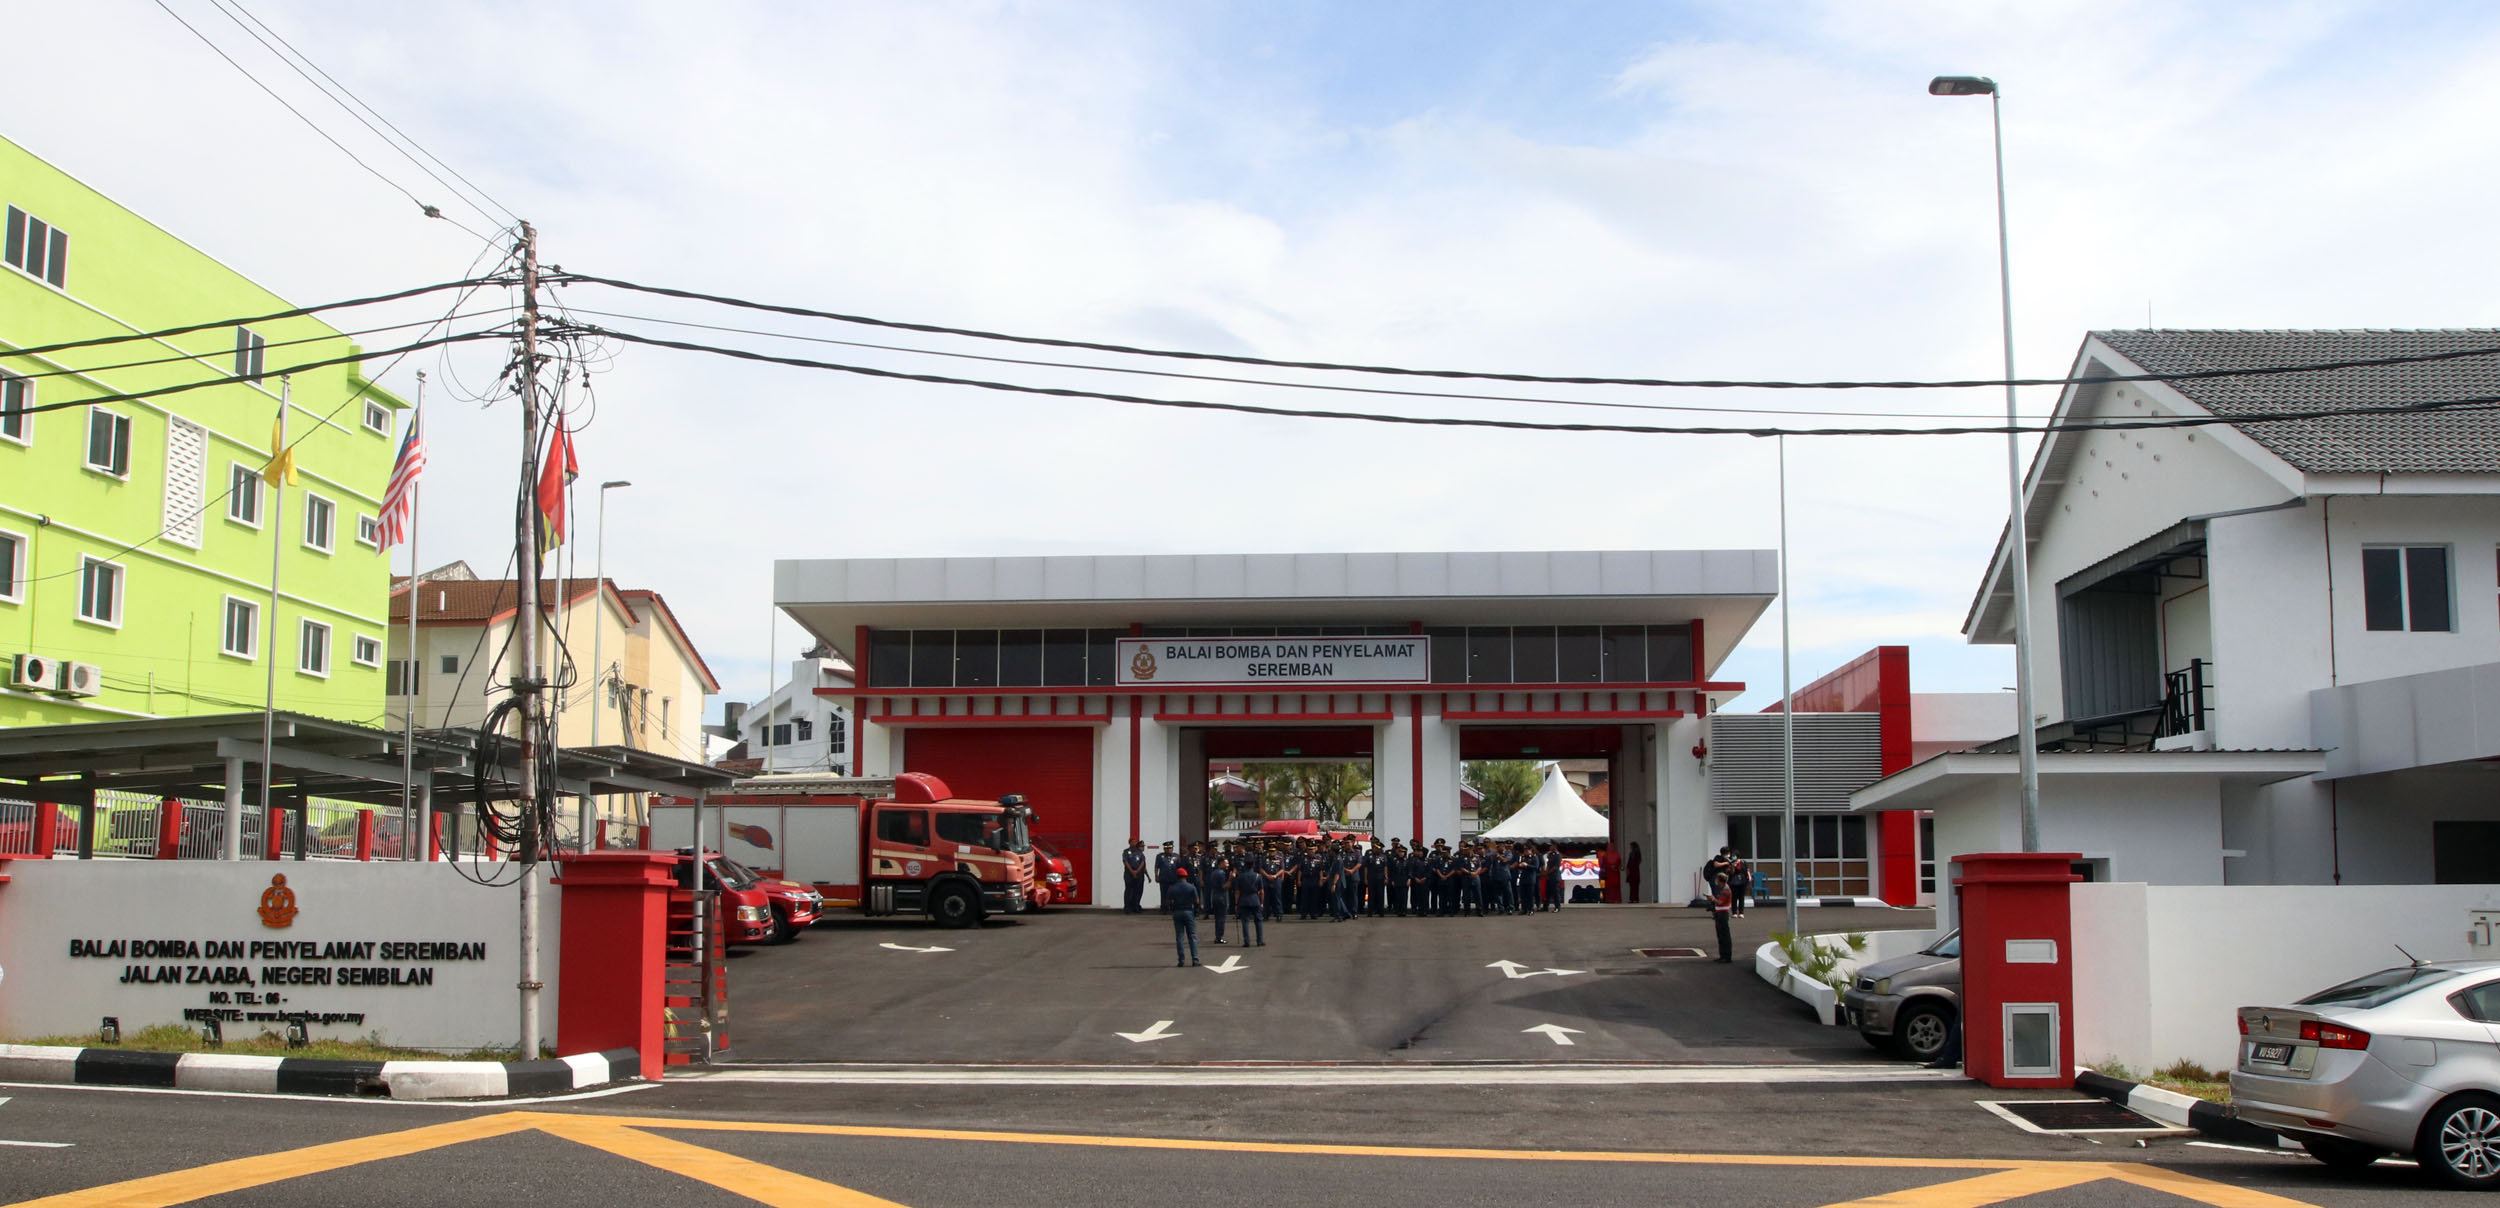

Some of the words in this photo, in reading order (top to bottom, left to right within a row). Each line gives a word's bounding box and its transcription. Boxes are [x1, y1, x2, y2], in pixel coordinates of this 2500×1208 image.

[1166, 645, 1212, 659] BALAI
[1215, 645, 1271, 659] BOMBA
[1276, 644, 1308, 658] DAN
[1312, 643, 1415, 658] PENYELAMAT
[1247, 663, 1333, 677] SEREMBAN
[70, 939, 127, 958] BALAI
[131, 940, 200, 959] BOMBA
[204, 941, 244, 959] DAN
[250, 941, 375, 960] PENYELAMAT
[380, 942, 486, 961] SEREMBAN
[120, 965, 182, 984] JALAN
[185, 966, 256, 988] ZAABA,
[261, 967, 332, 985] NEGERI
[336, 968, 433, 986] SEMBILAN
[209, 991, 232, 1005] NO.
[234, 992, 263, 1006] TEL:
[183, 1008, 245, 1022] WEBSITE:
